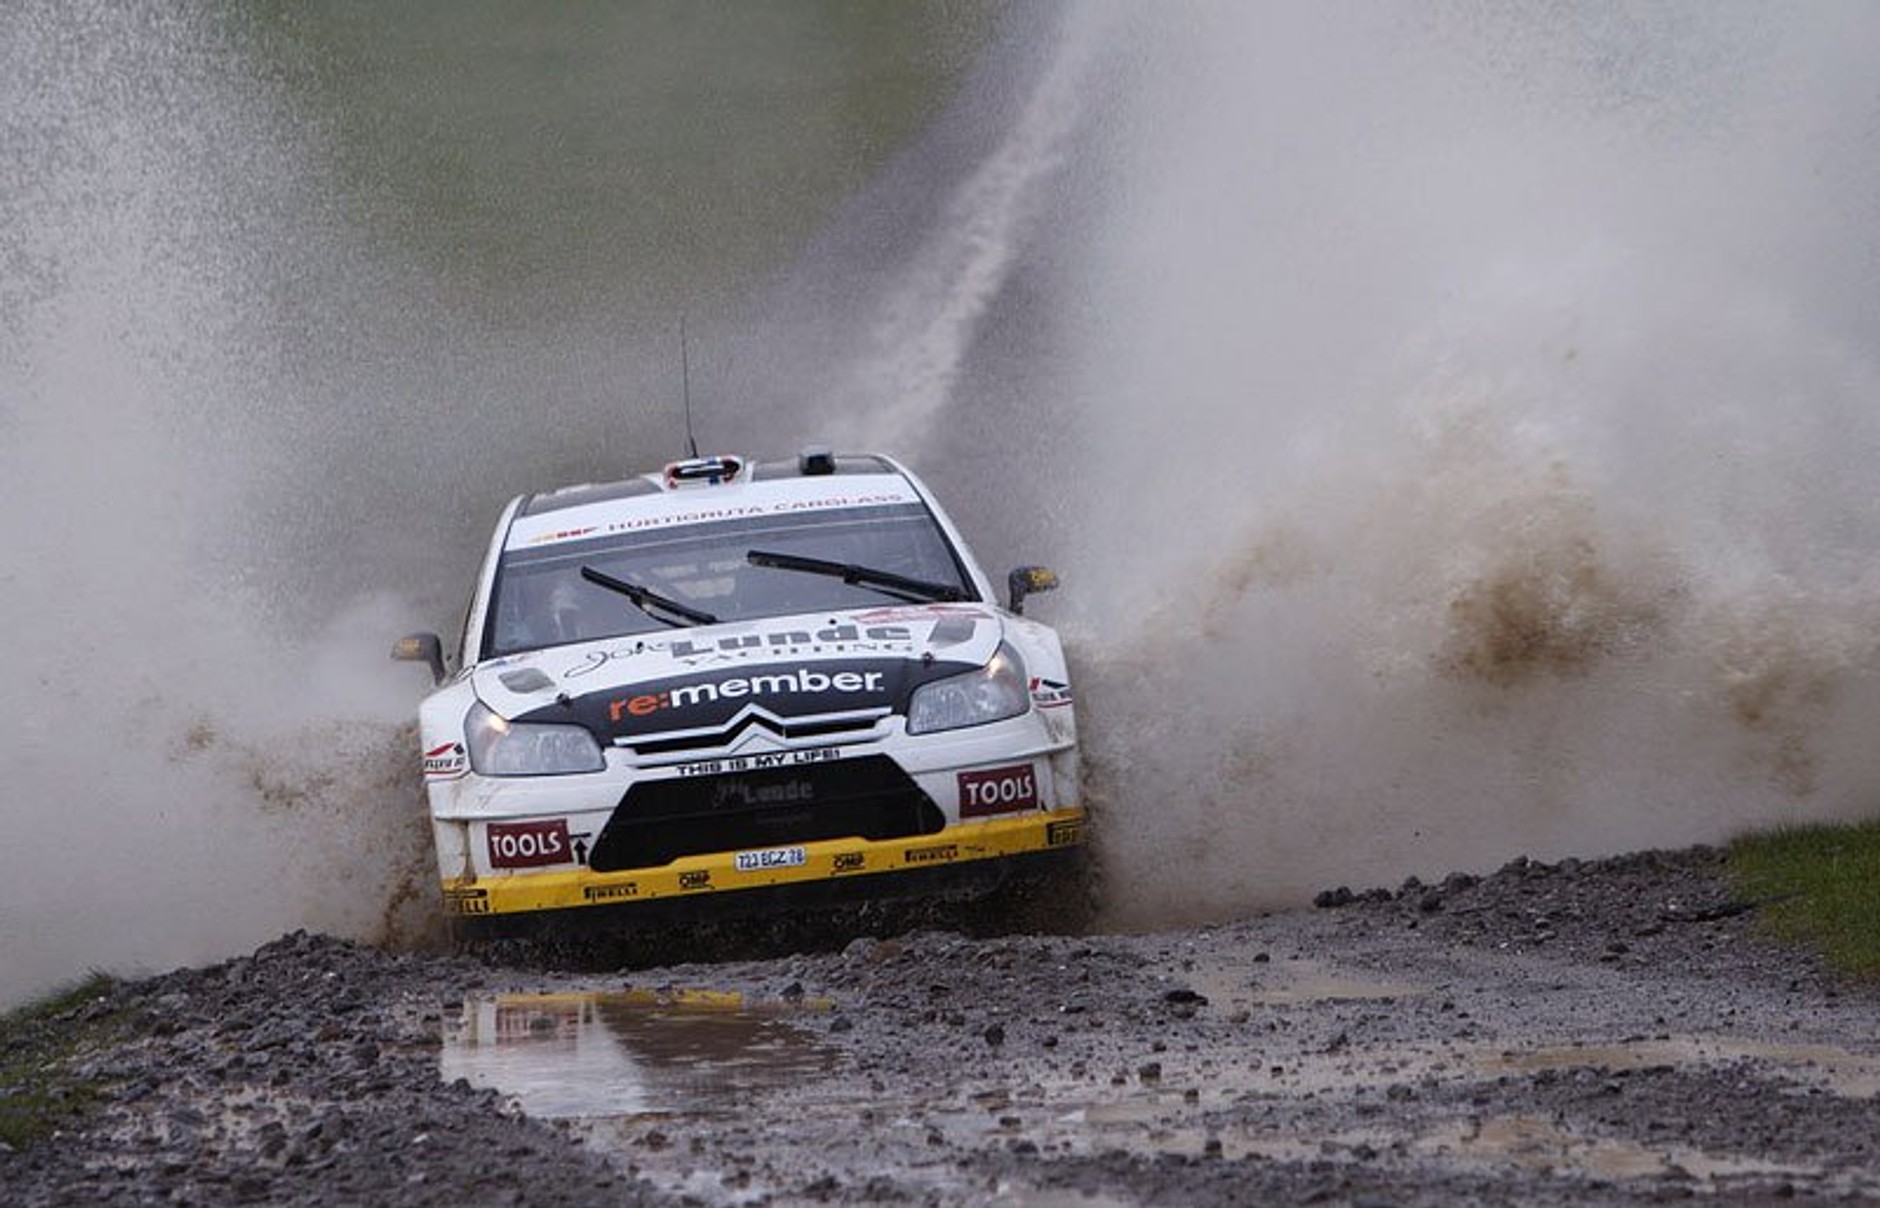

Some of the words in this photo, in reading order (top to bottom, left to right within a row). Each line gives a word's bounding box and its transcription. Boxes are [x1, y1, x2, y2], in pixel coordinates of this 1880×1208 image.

[671, 624, 911, 658] Lunde
[676, 761, 722, 777] THIS
[729, 758, 748, 771] IS
[755, 754, 785, 768] MY
[794, 749, 841, 764] LIFE!
[965, 775, 1034, 806] TOOLS
[490, 831, 562, 858] TOOLS
[584, 882, 639, 903] PIRELLI
